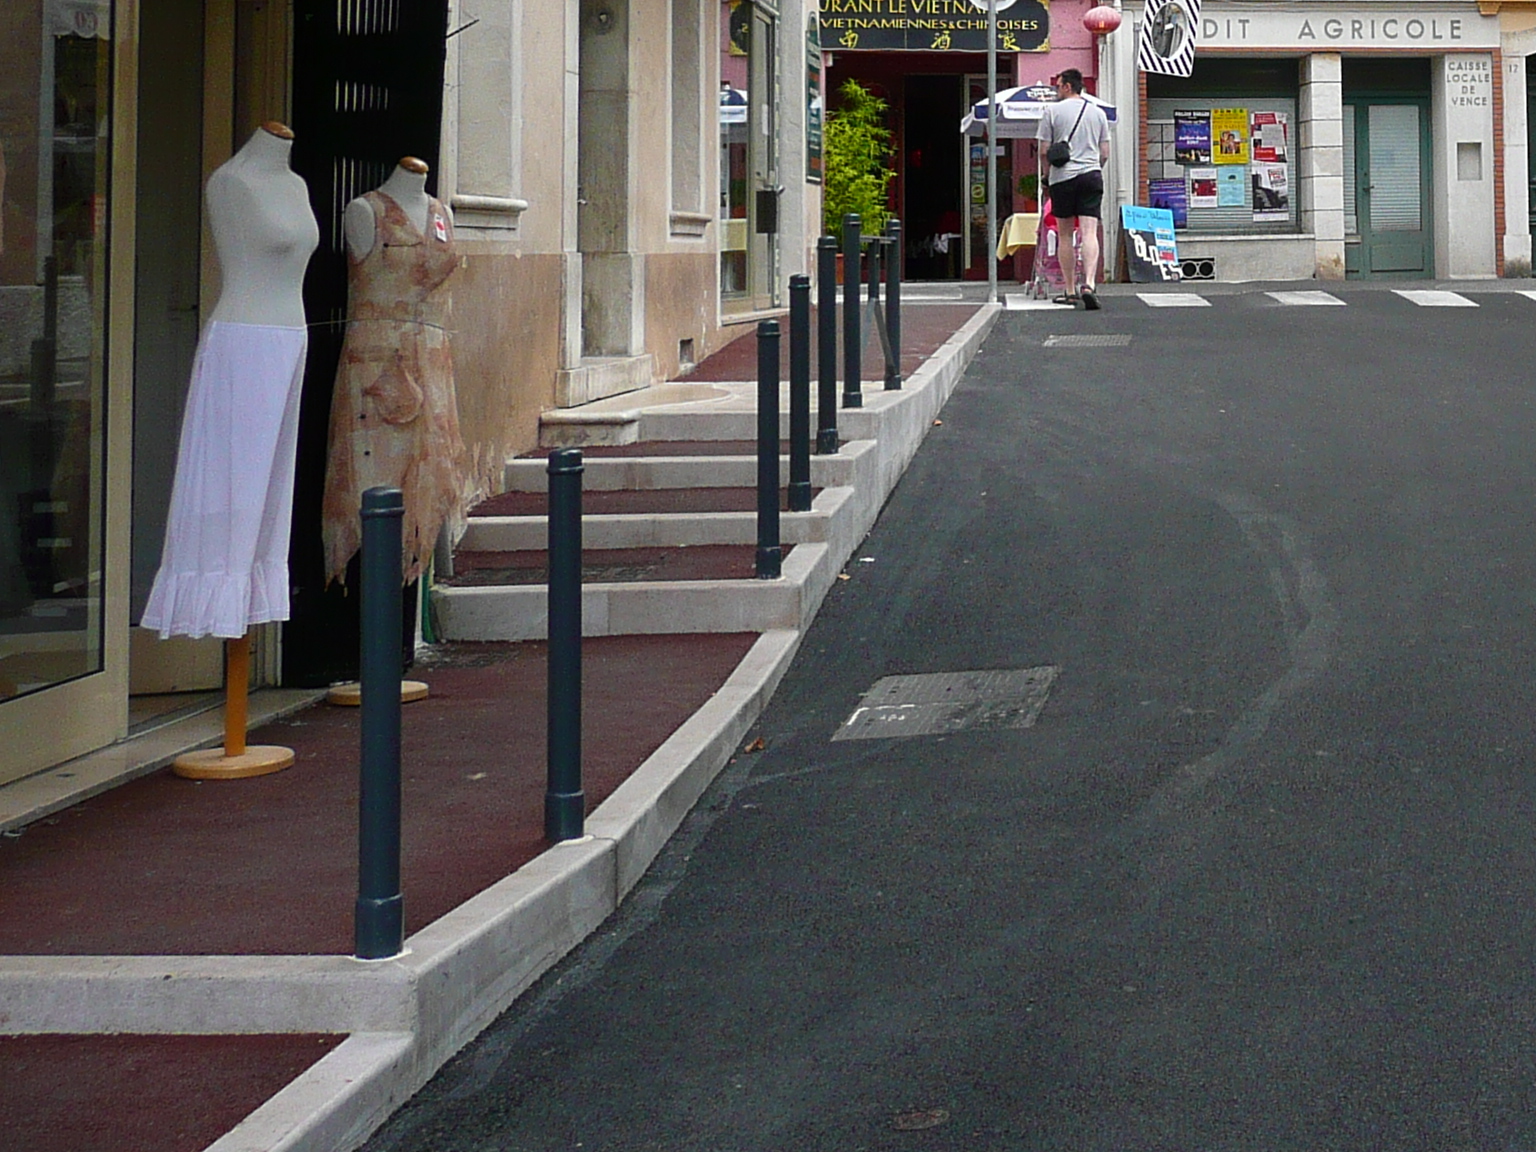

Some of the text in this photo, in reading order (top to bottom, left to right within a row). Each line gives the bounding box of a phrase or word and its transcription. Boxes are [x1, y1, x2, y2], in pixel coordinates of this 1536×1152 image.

[1202, 18, 1462, 40] DIT AGRICOLE
[1448, 61, 1488, 71] CAISSE
[1446, 73, 1490, 83] LOCALE
[1461, 85, 1476, 95] DE
[1452, 96, 1488, 107] VENCE
